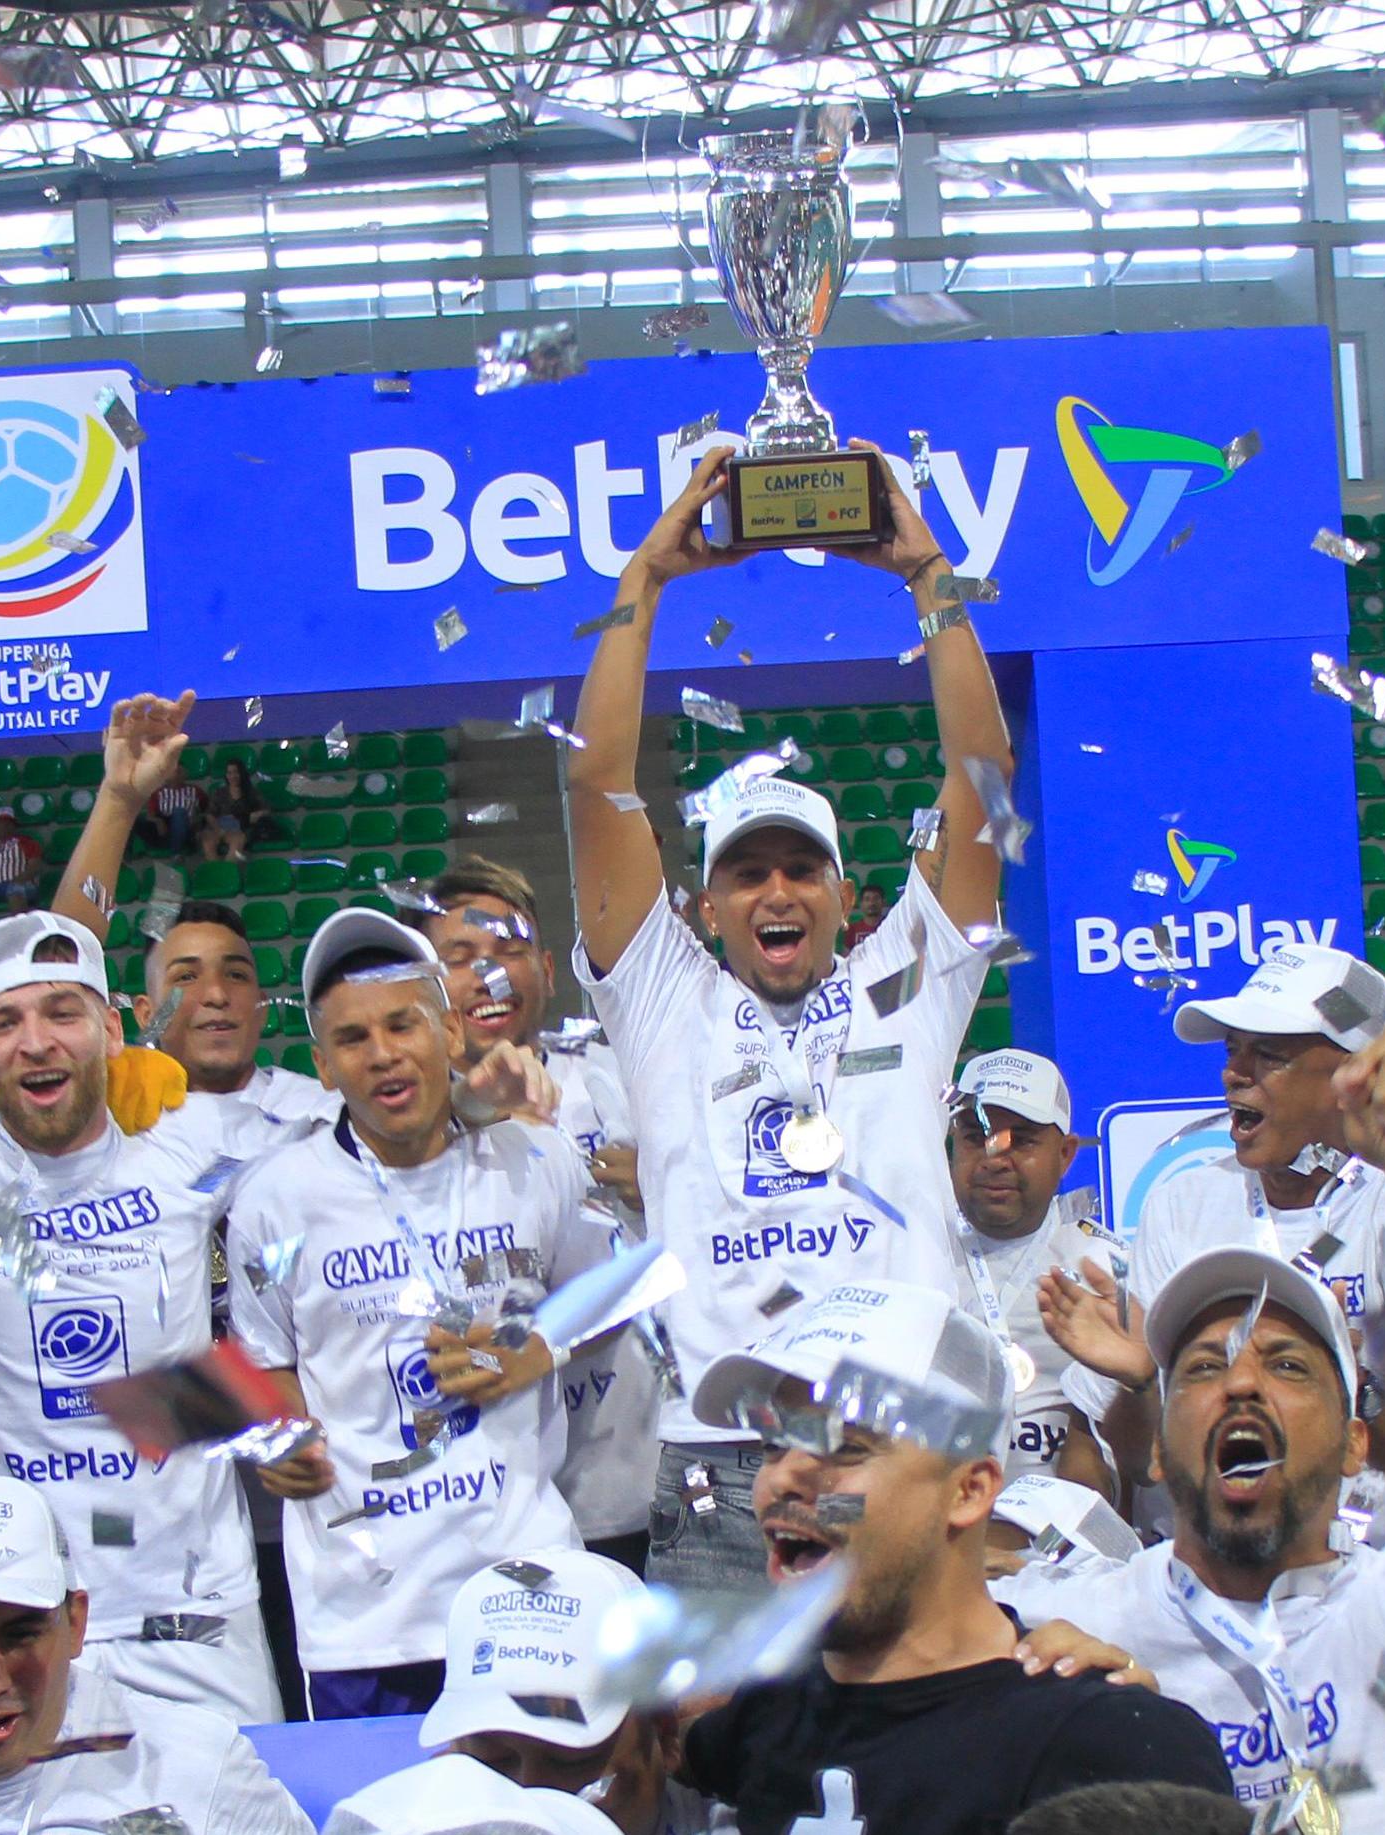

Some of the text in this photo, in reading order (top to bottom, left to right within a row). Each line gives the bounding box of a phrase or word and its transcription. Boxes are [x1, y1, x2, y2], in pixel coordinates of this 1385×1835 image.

[840, 507, 861, 520] FCF
[50, 708, 80, 728] FCF
[713, 1221, 838, 1264] BetPlay
[109, 1255, 152, 1273] 2024
[5, 1447, 139, 1481] BetPlay
[363, 1470, 485, 1517] BetPlay
[480, 1589, 580, 1617] CAMPEONES
[498, 1646, 559, 1665] BetPlay
